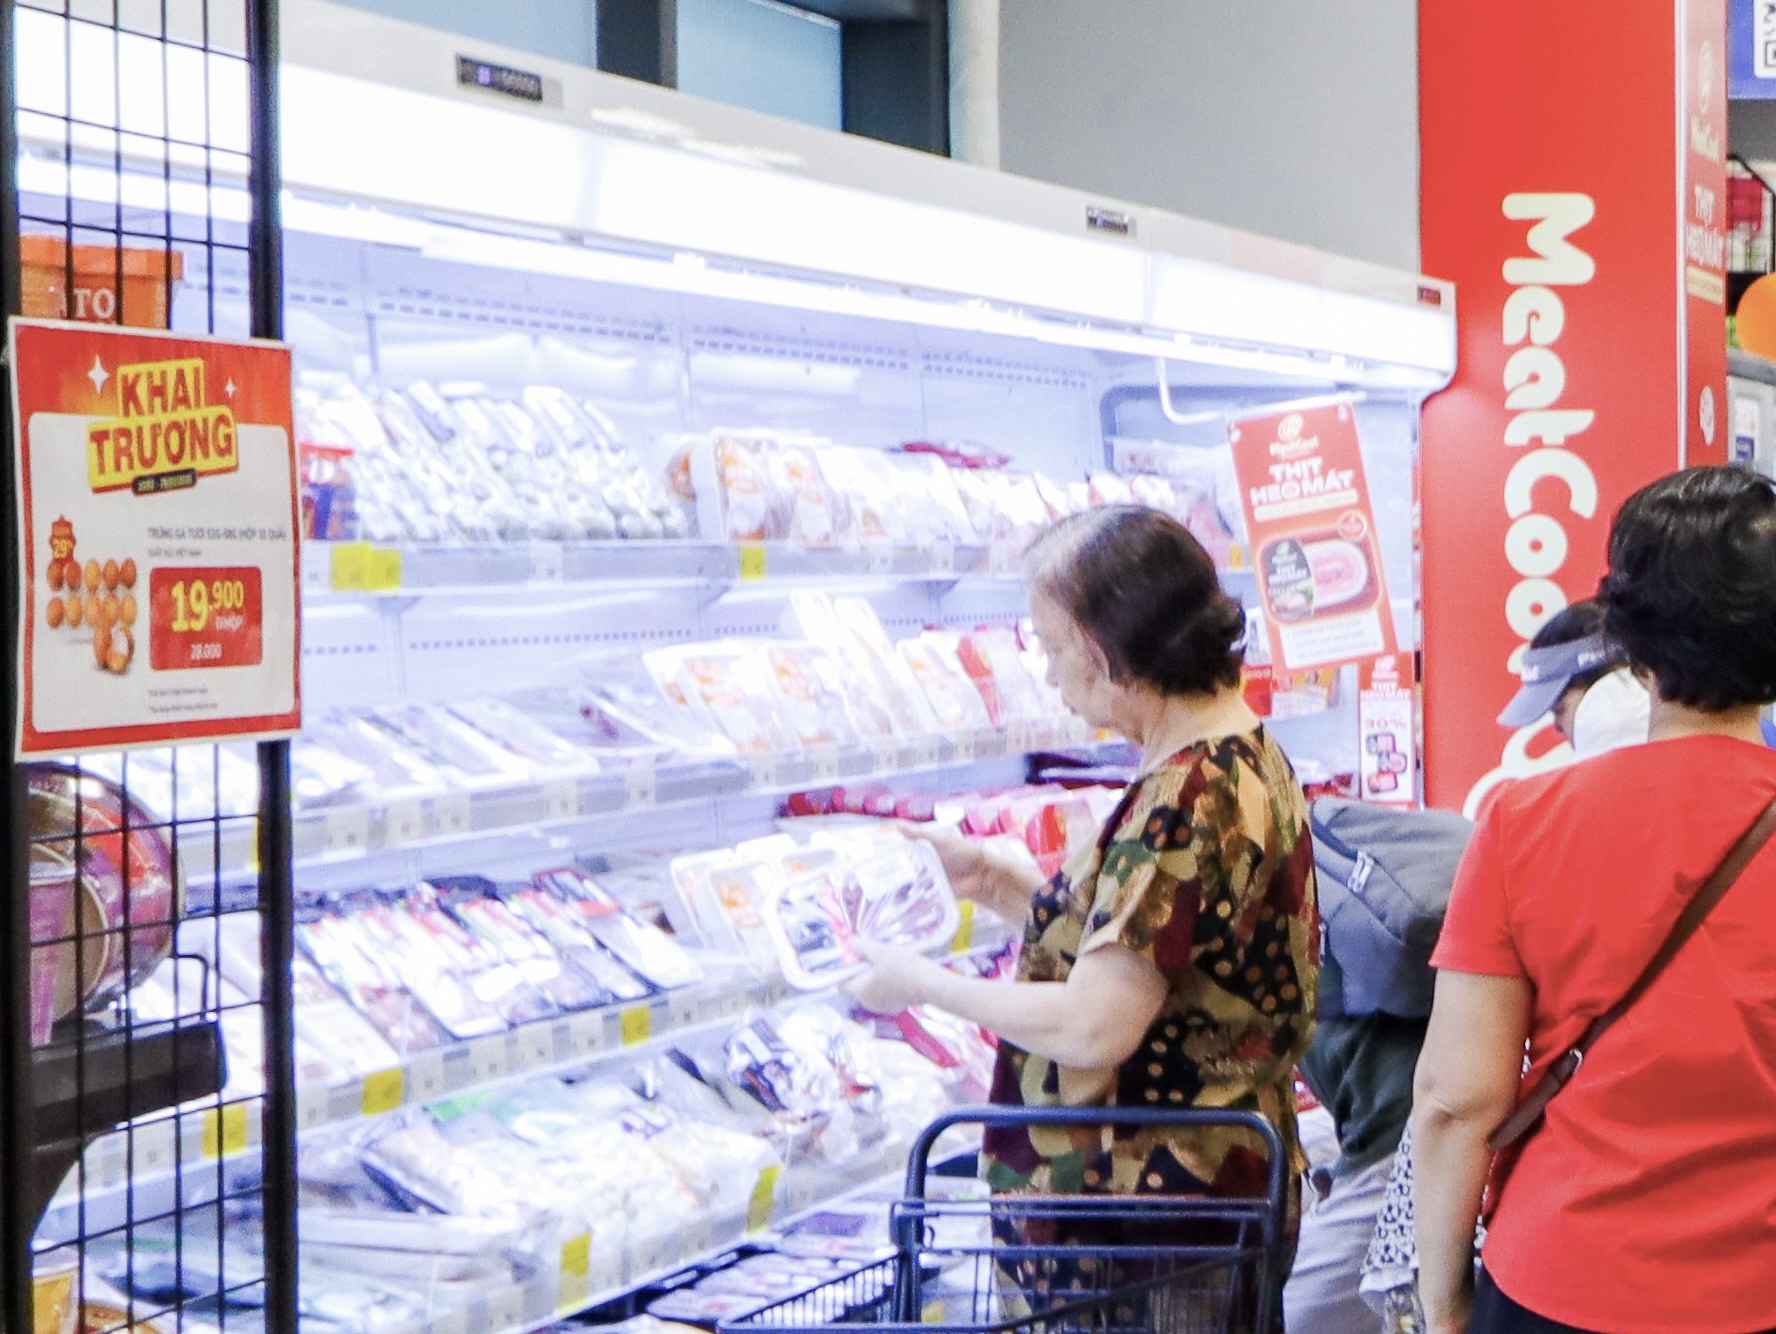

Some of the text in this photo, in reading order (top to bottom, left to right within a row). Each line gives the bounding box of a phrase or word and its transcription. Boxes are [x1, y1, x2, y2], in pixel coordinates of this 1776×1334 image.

[120, 365, 205, 418] KHAI
[90, 413, 234, 476] TRƯƠNG
[1501, 192, 1599, 679] MeatCoo
